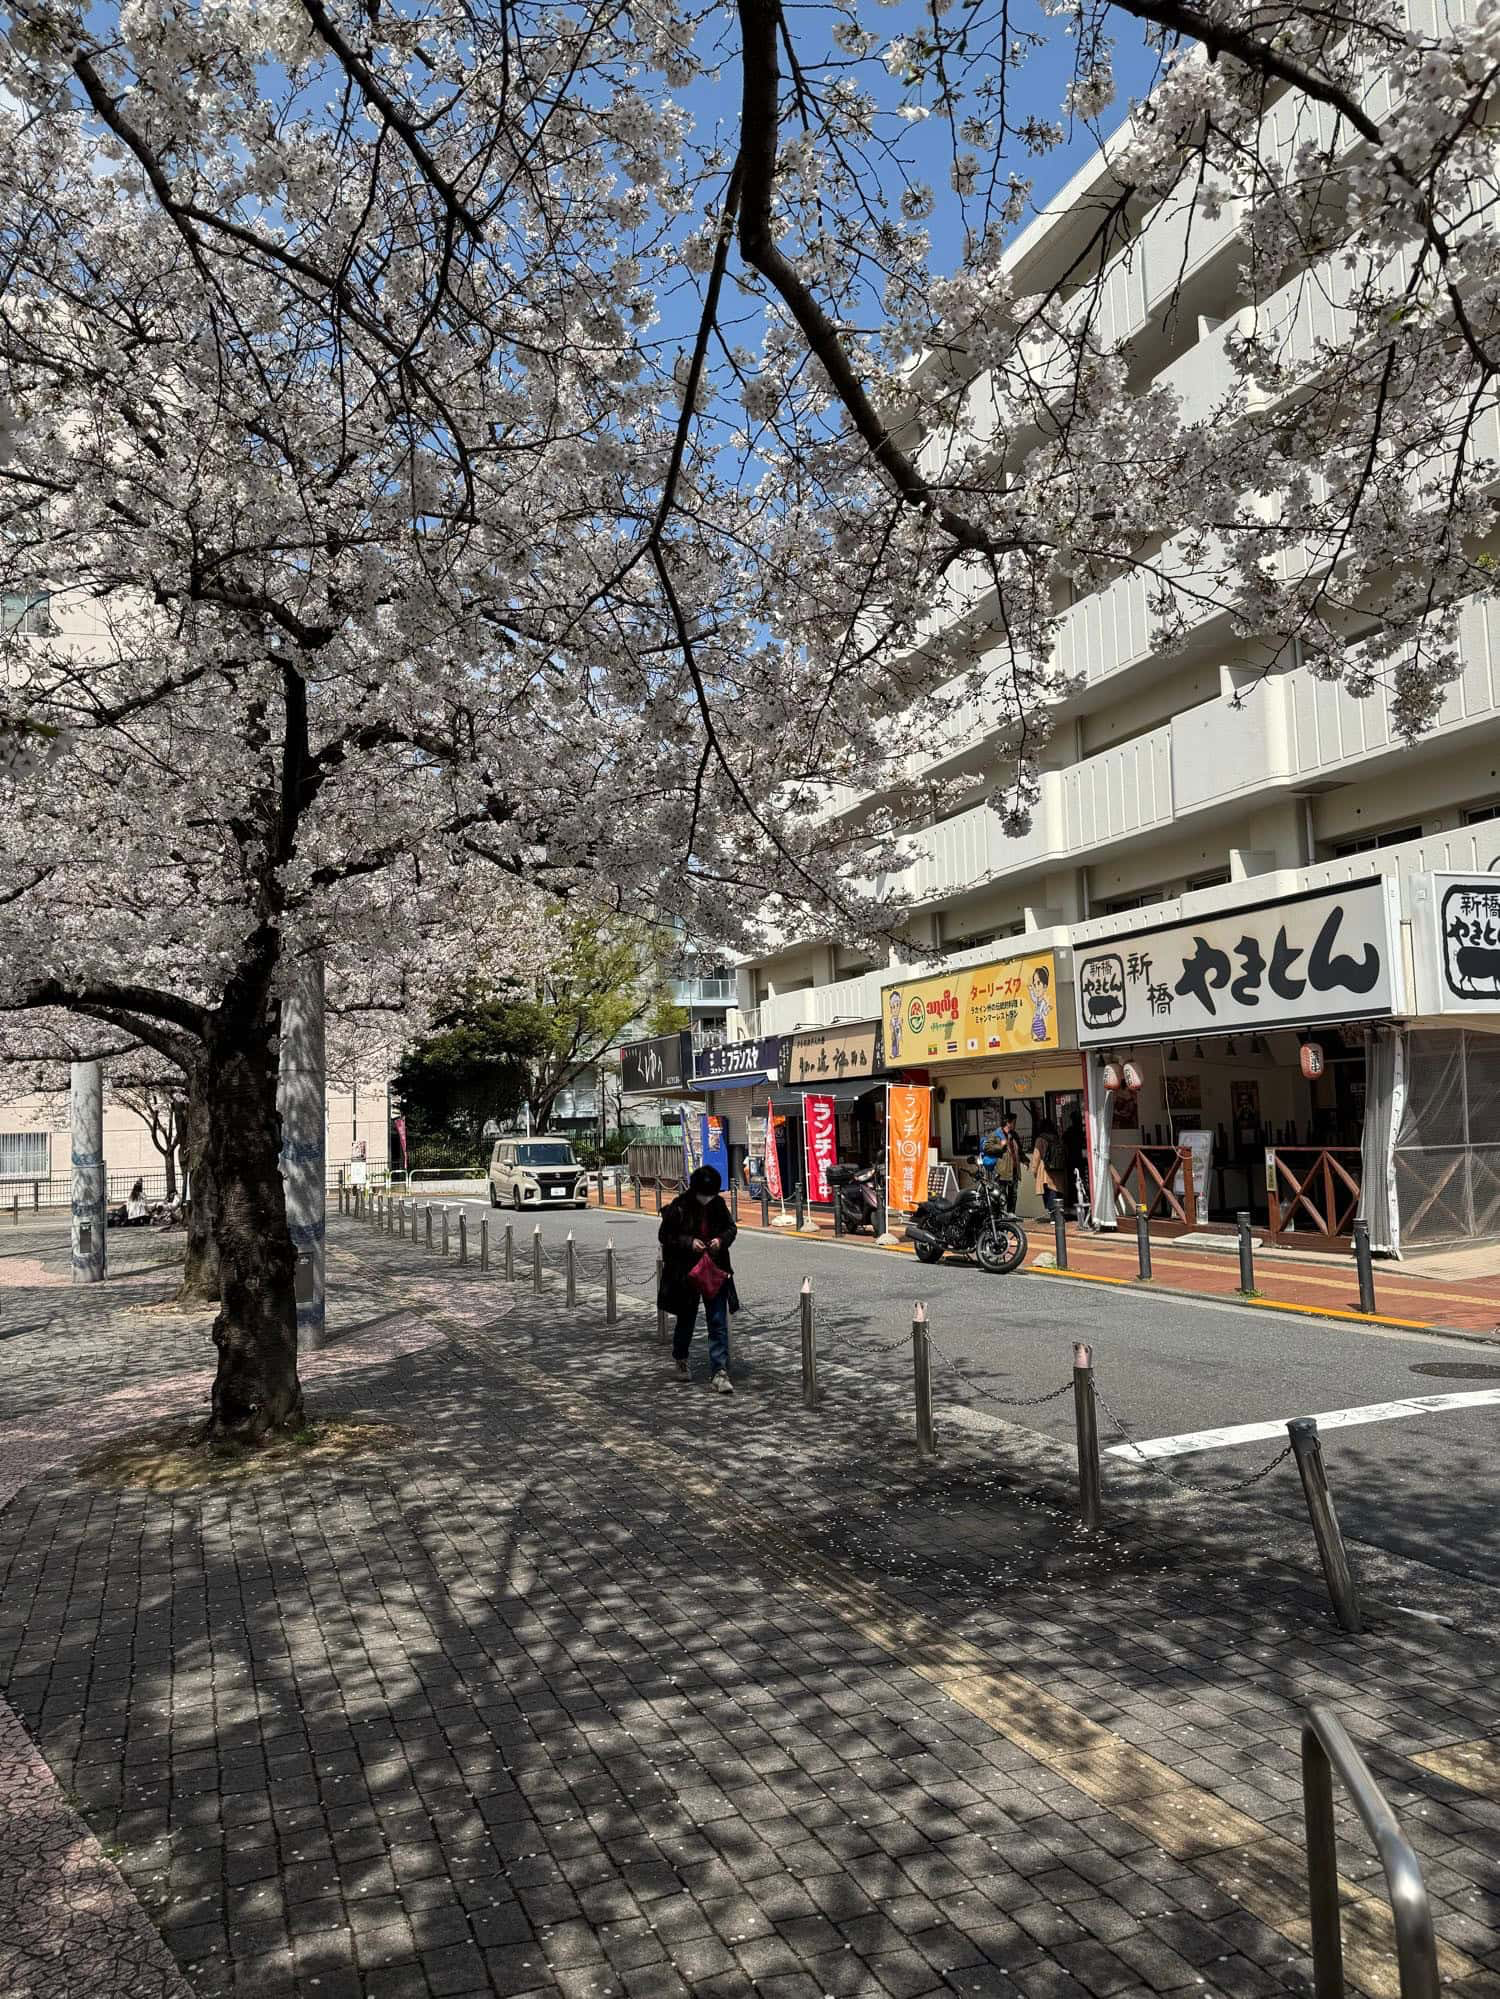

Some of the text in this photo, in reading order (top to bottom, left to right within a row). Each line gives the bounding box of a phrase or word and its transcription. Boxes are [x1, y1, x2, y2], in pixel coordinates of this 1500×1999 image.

[1461, 893, 1500, 919] 新橋
[1447, 915, 1500, 947] やきと
[1089, 962, 1113, 977] 新橋
[1126, 905, 1380, 1016] 新橋 やきとん
[1083, 973, 1122, 994] やきとん
[903, 1093, 916, 1139] ランチ
